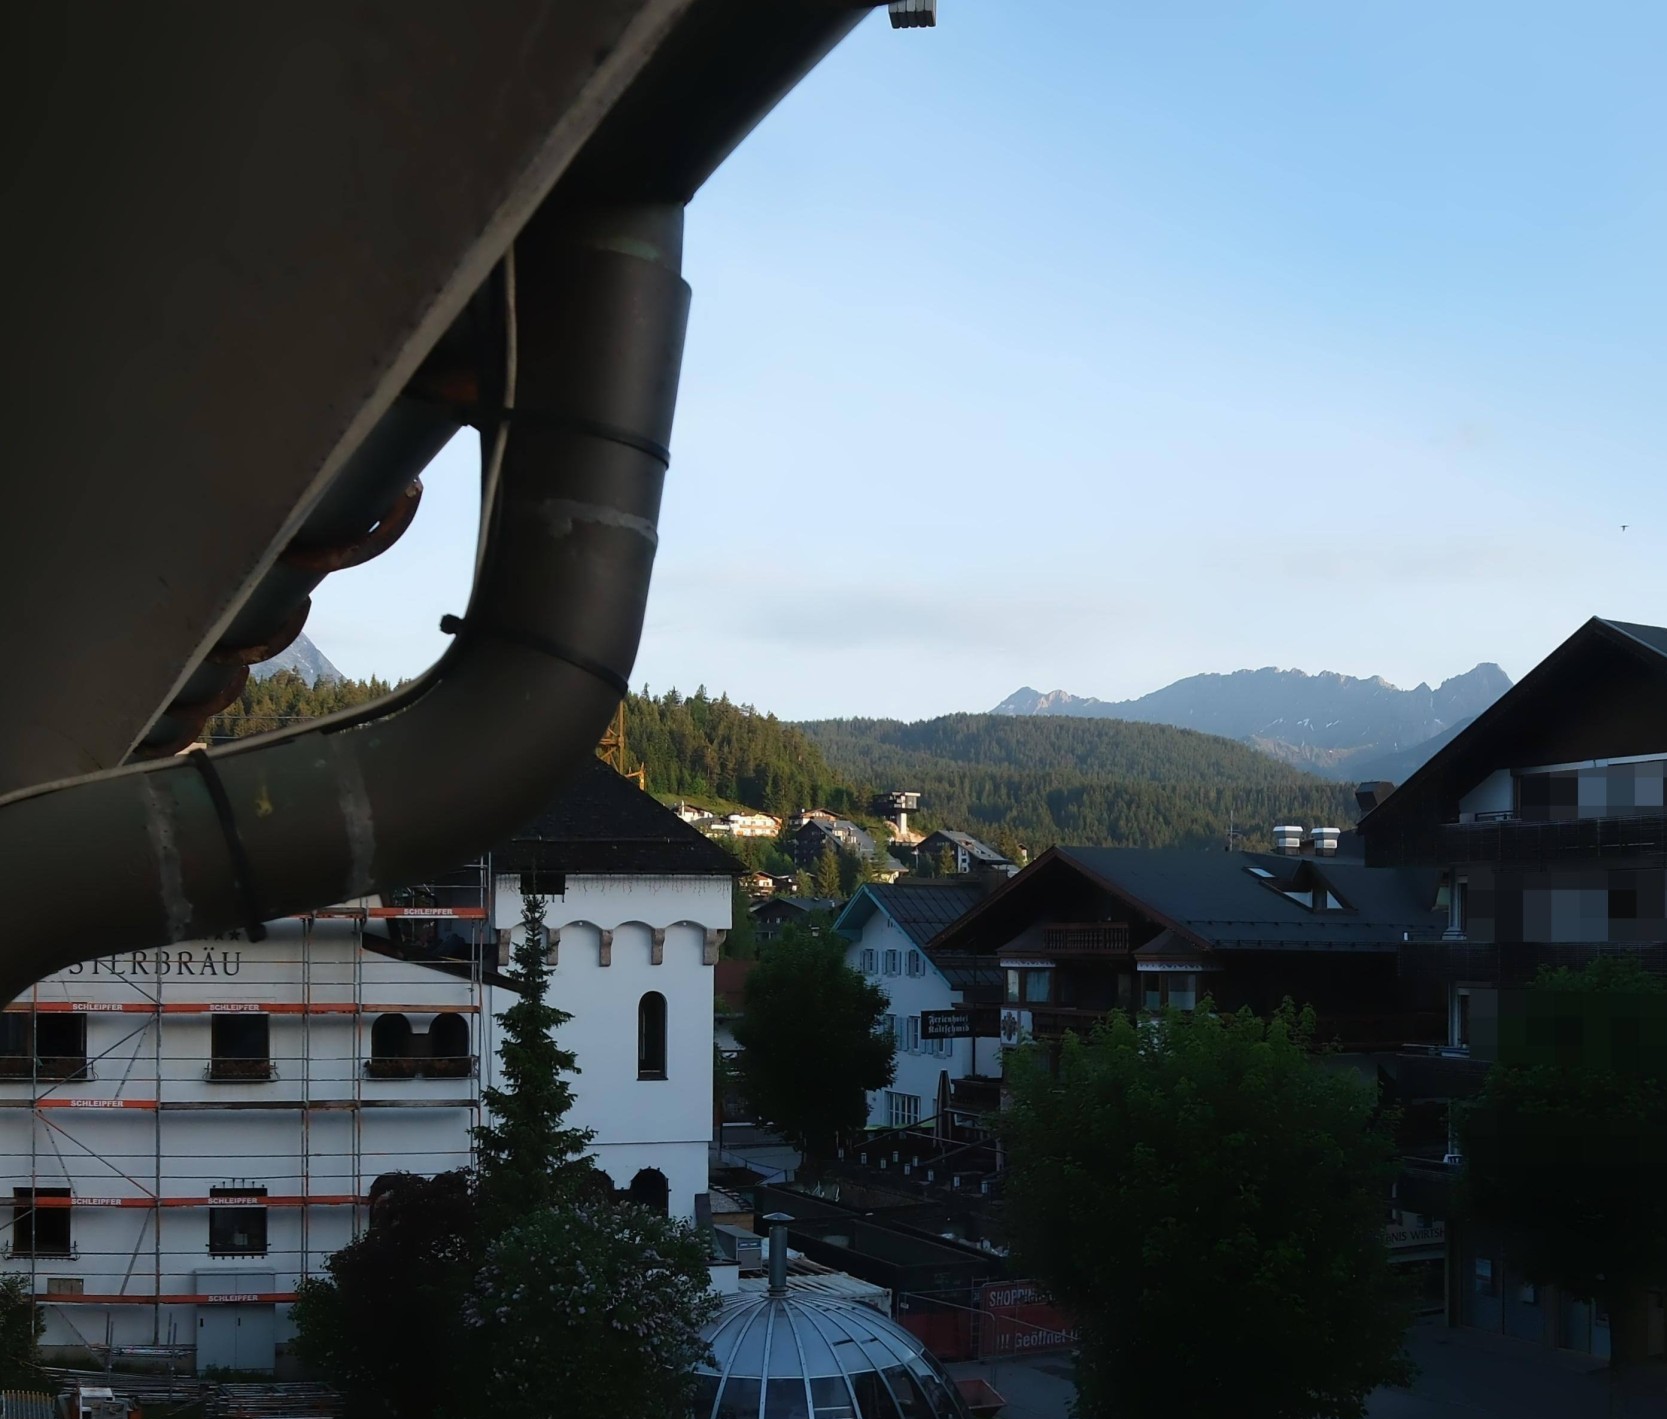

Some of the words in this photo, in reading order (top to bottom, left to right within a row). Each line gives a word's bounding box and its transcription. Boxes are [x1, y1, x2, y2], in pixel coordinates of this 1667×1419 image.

[69, 947, 242, 976] STERBRÄU
[72, 1003, 123, 1011] SCHLEIPFER
[71, 1099, 124, 1107] SCHLEIPFER
[71, 1198, 122, 1206] SCHLEIPFER
[208, 1196, 258, 1204] SCHLEIPFER
[208, 1294, 258, 1302] SCHLEIPFER
